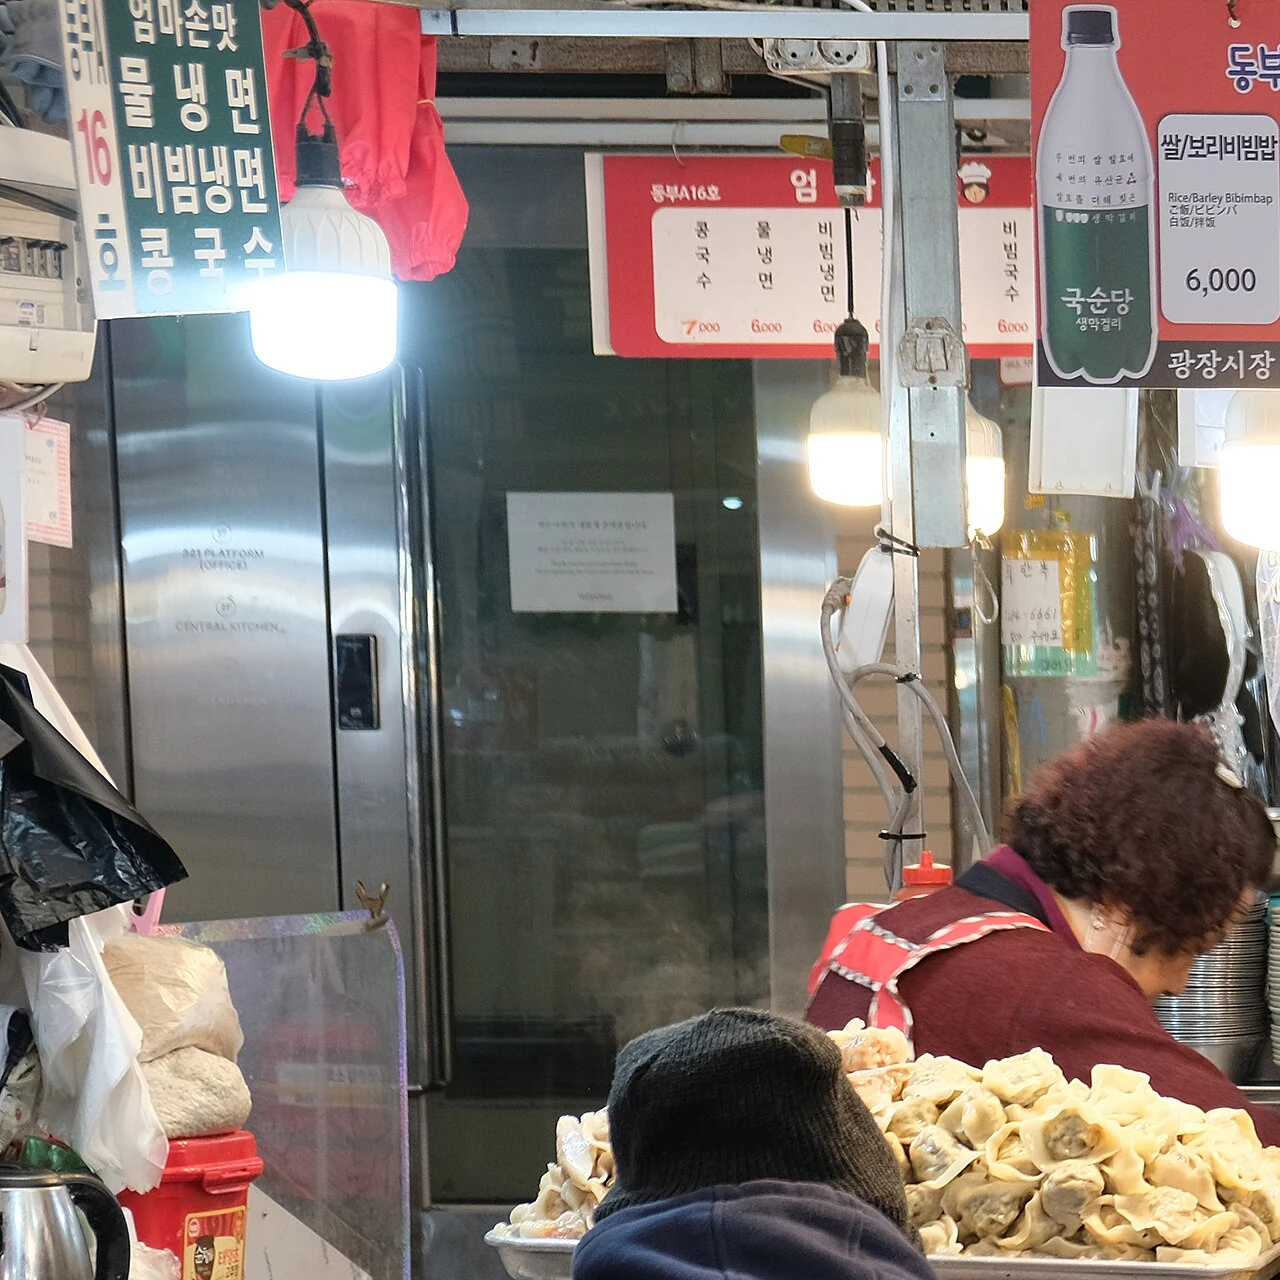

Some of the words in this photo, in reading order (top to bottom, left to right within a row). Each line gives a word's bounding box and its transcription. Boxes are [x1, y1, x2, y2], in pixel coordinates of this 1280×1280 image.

[129, 0, 240, 52] 엄마손맛
[77, 109, 112, 186] 16
[1160, 134, 1279, 161] 쌀/보리비빔밥
[127, 142, 269, 214] 비빔냉면
[651, 183, 721, 203] 동부A16호
[1168, 193, 1223, 206] Rice/Barley
[1226, 193, 1273, 205] Bibimbap
[94, 212, 126, 292] 호
[694, 221, 711, 290] 콩국수
[756, 220, 774, 290] 물냉면
[817, 220, 836, 302] 비빔냉면
[1002, 220, 1020, 302] 비빔국수
[1061, 287, 1134, 316] 국순당
[1186, 268, 1256, 297] 6,000
[1076, 317, 1121, 332] 생막걸리
[1167, 350, 1275, 380] 광장시장
